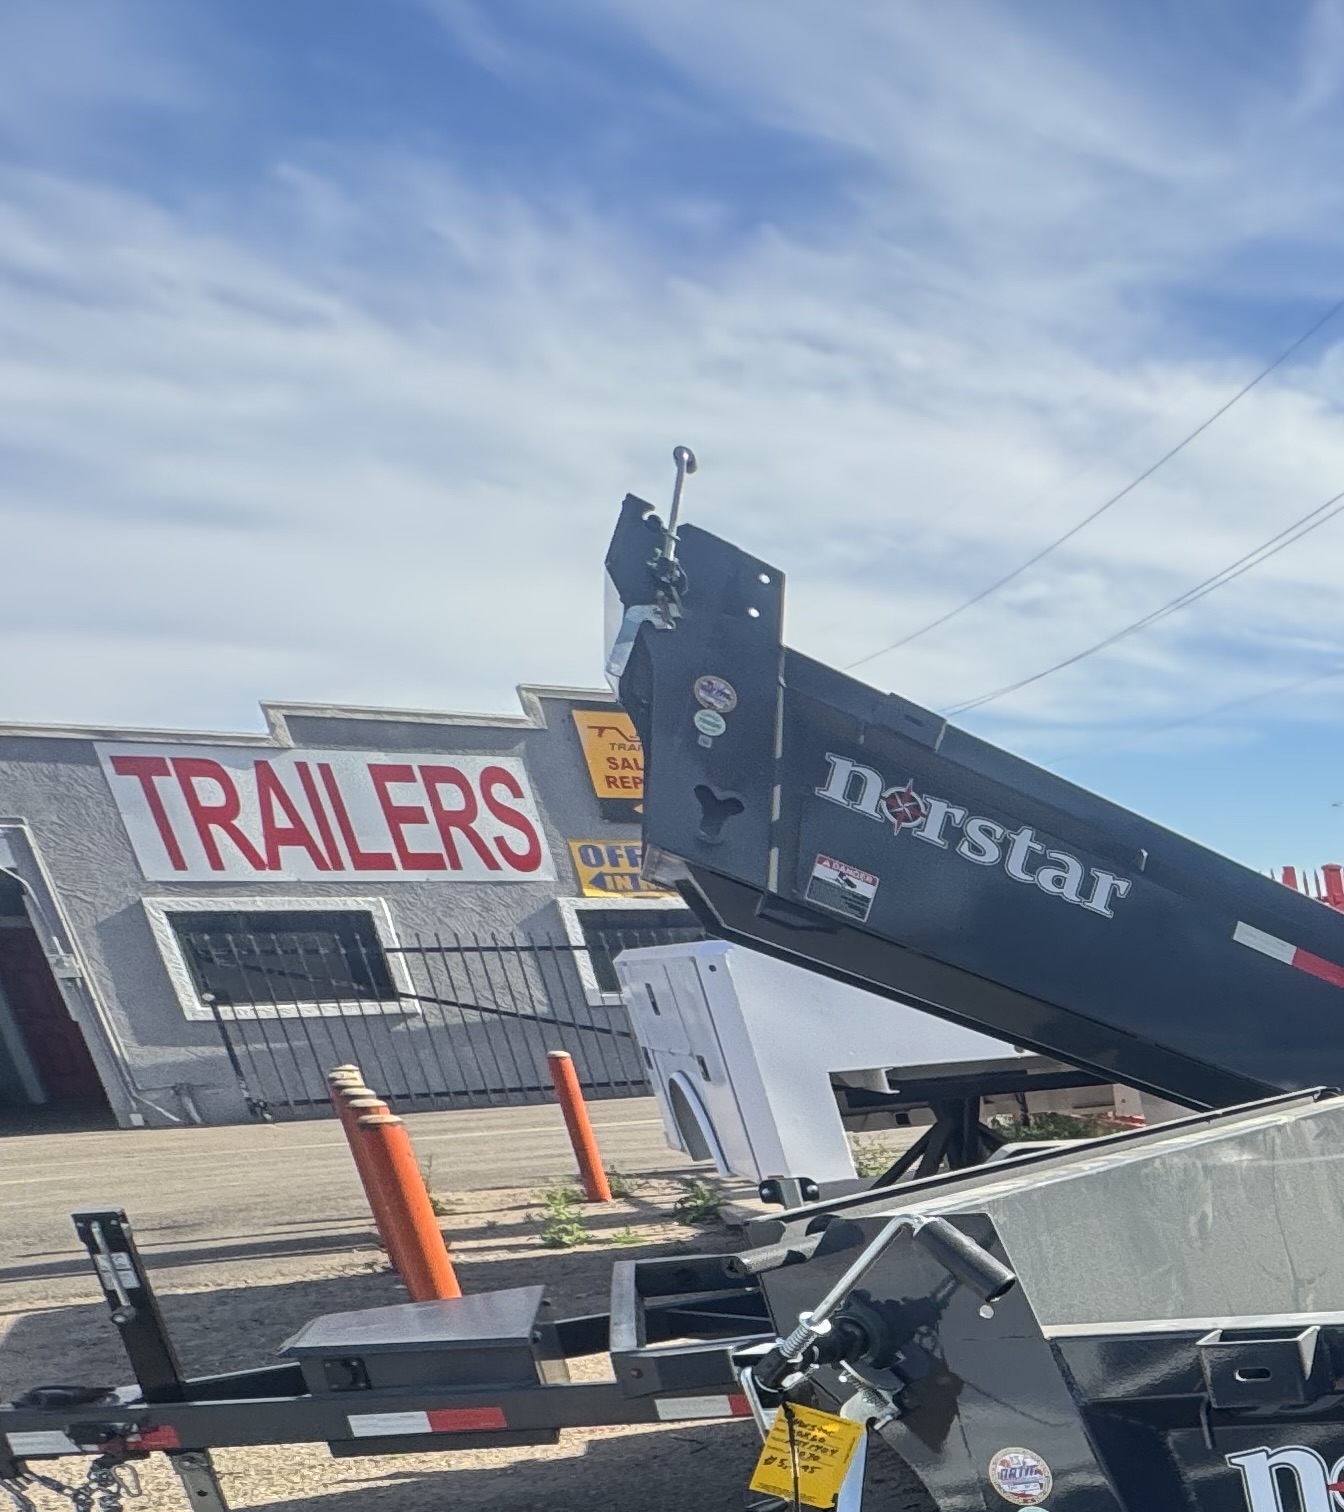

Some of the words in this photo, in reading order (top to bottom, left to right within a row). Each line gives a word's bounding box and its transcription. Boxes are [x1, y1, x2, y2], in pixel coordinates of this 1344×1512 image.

[606, 756, 645, 772] SAL
[604, 775, 644, 790] REP
[109, 754, 544, 874] TRAILERS
[815, 752, 1132, 919] norstar
[577, 844, 642, 868] OFF
